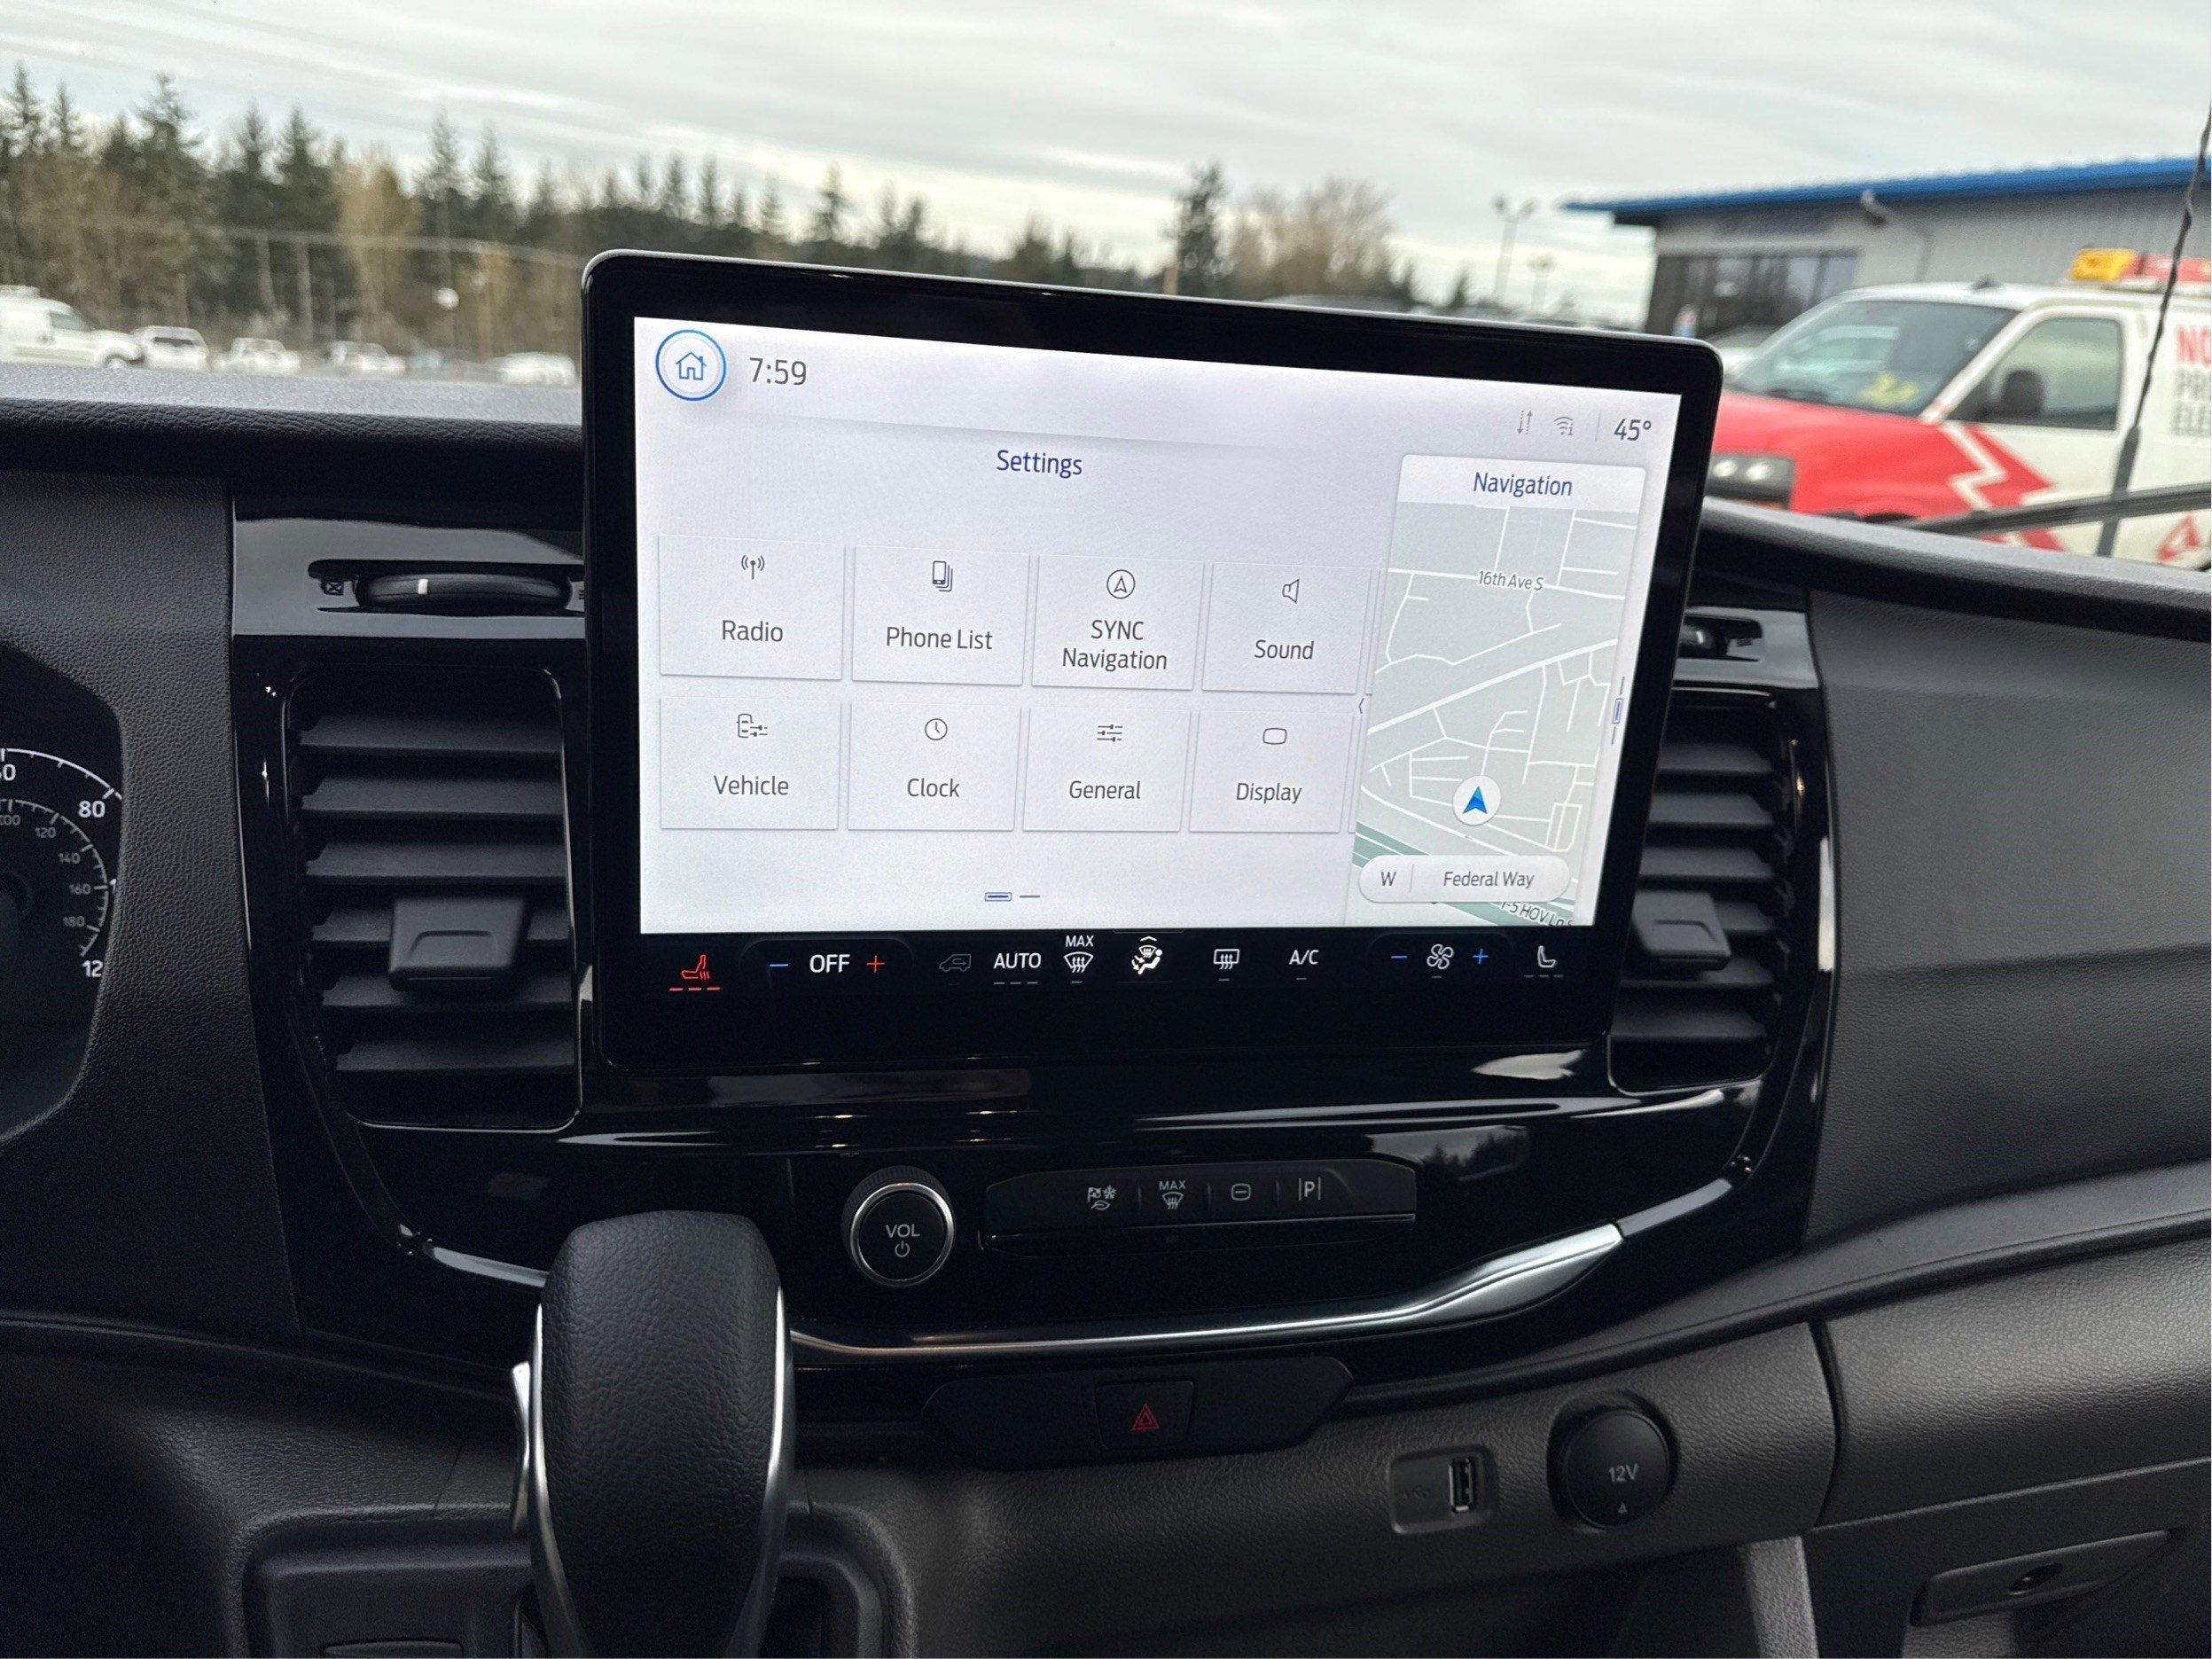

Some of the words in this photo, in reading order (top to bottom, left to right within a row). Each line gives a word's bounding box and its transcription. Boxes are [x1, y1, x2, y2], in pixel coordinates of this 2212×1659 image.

[749, 357, 808, 386] 7:59
[1614, 419, 1652, 441] 45°
[997, 449, 1083, 479] Settings
[1473, 472, 1573, 498] Navigation
[1479, 571, 1505, 586] 16th
[1507, 574, 1532, 590] Ave
[1534, 576, 1544, 591] S
[722, 619, 784, 643] Radio
[886, 627, 952, 649] Phone
[957, 628, 993, 650] List
[1090, 620, 1144, 641] SYNC
[1062, 647, 1168, 672] Navigation
[1254, 639, 1314, 661] Sound
[0, 763, 16, 781] 0
[714, 775, 789, 796] Vehicle
[907, 778, 960, 799] Clock
[1069, 780, 1141, 800] General
[1236, 782, 1302, 804] Display
[78, 801, 106, 818] 80
[35, 826, 56, 839] 120
[58, 852, 81, 865] 140
[1380, 871, 1396, 887] W
[1443, 871, 1498, 887] Federal
[1503, 871, 1535, 889] Way
[69, 884, 91, 896] 160
[1520, 904, 1549, 922] HOV
[1066, 935, 1094, 948] MAX
[809, 954, 850, 973] OFF
[993, 952, 1042, 969] AUTO
[1289, 950, 1318, 966] A/C
[82, 960, 103, 978] 12
[1159, 1180, 1186, 1191] MAX
[886, 1224, 920, 1238] VOL
[1607, 1463, 1638, 1483] 12V
